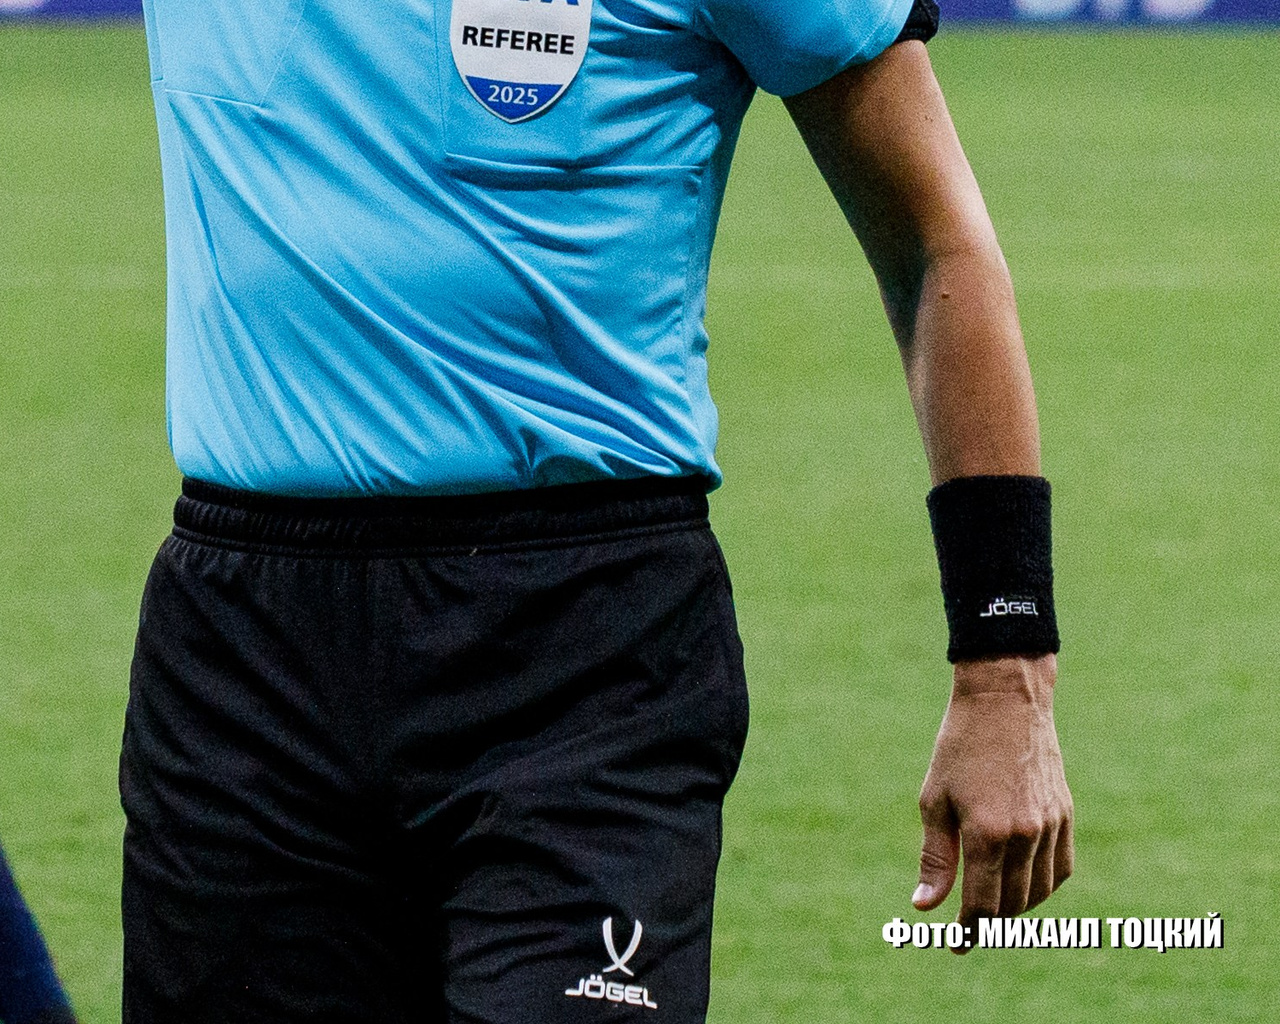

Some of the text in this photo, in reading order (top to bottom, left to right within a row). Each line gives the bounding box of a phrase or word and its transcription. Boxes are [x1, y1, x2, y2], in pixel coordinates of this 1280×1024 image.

[462, 25, 576, 56] REFEREE
[487, 84, 539, 107] 2025
[980, 597, 1039, 617] JÖGEL
[564, 973, 658, 1010] JÖGEL
